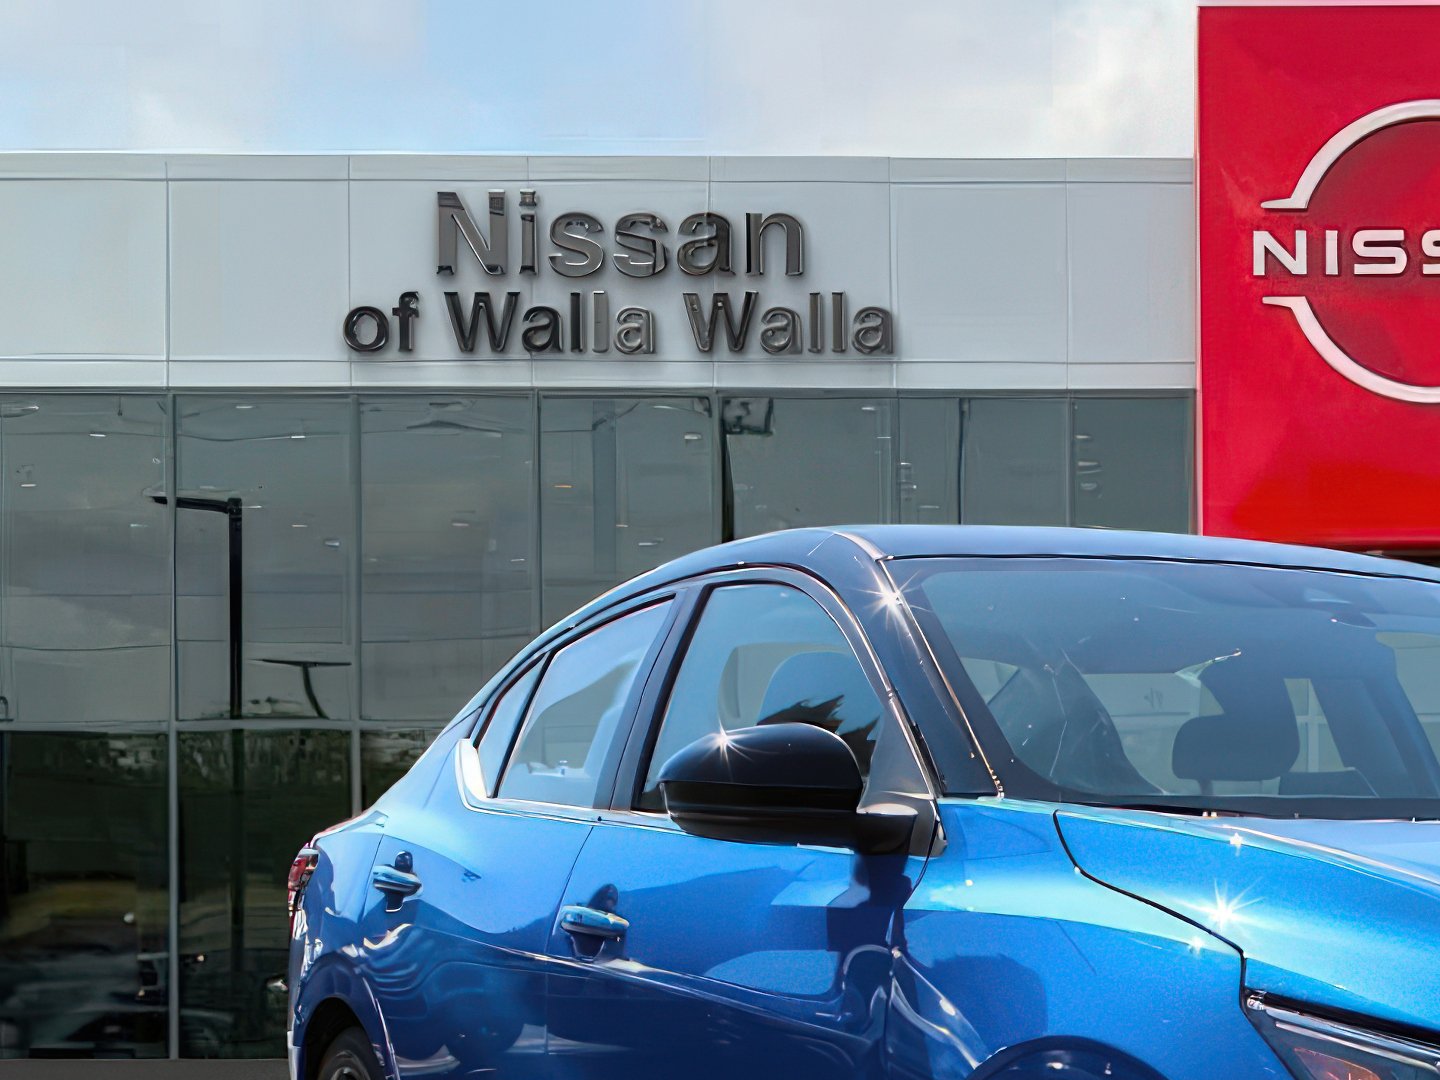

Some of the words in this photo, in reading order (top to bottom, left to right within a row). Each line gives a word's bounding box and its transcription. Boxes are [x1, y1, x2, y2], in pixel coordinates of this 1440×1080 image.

[435, 189, 804, 277] Nissan
[342, 290, 420, 353] of
[443, 290, 656, 353] Walla
[682, 290, 894, 354] Walla
